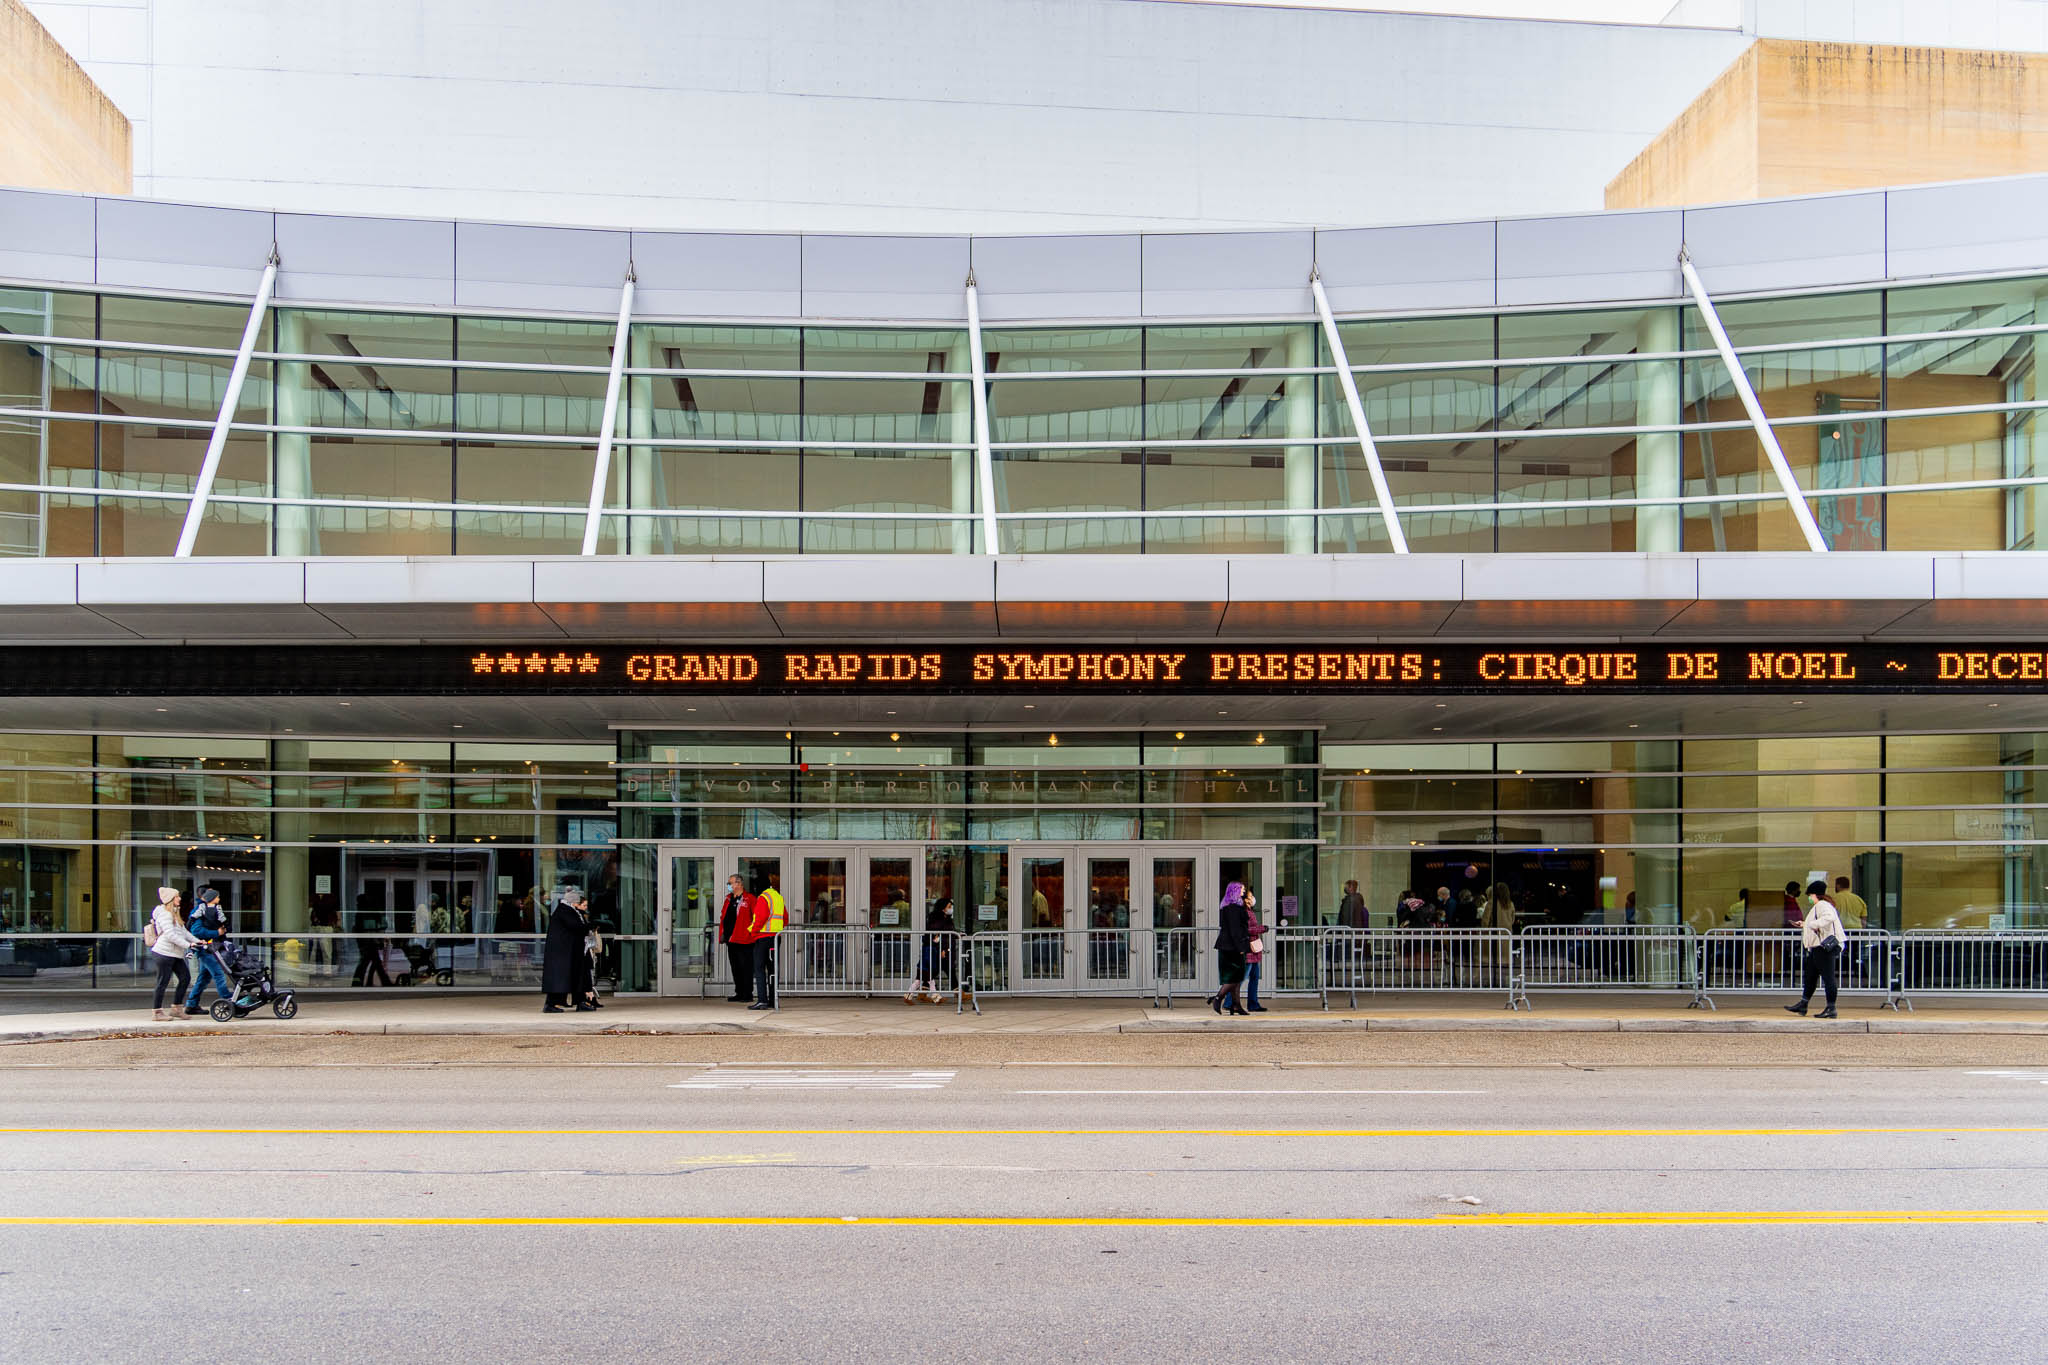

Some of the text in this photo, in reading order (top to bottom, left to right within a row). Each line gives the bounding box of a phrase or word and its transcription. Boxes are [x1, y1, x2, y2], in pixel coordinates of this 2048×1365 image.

[627, 654, 758, 681] GRAND
[785, 654, 941, 681] RAPIDS
[973, 654, 1186, 681] SYMPHONY
[1210, 654, 1441, 681] PRESENTS:
[1478, 653, 1637, 685] CIRQUE
[1668, 652, 1718, 680] DE
[1747, 652, 1856, 680] NOEL
[1938, 652, 2048, 680] DECE
[626, 780, 1309, 793] DE VOS PERFORMANCE HALL
